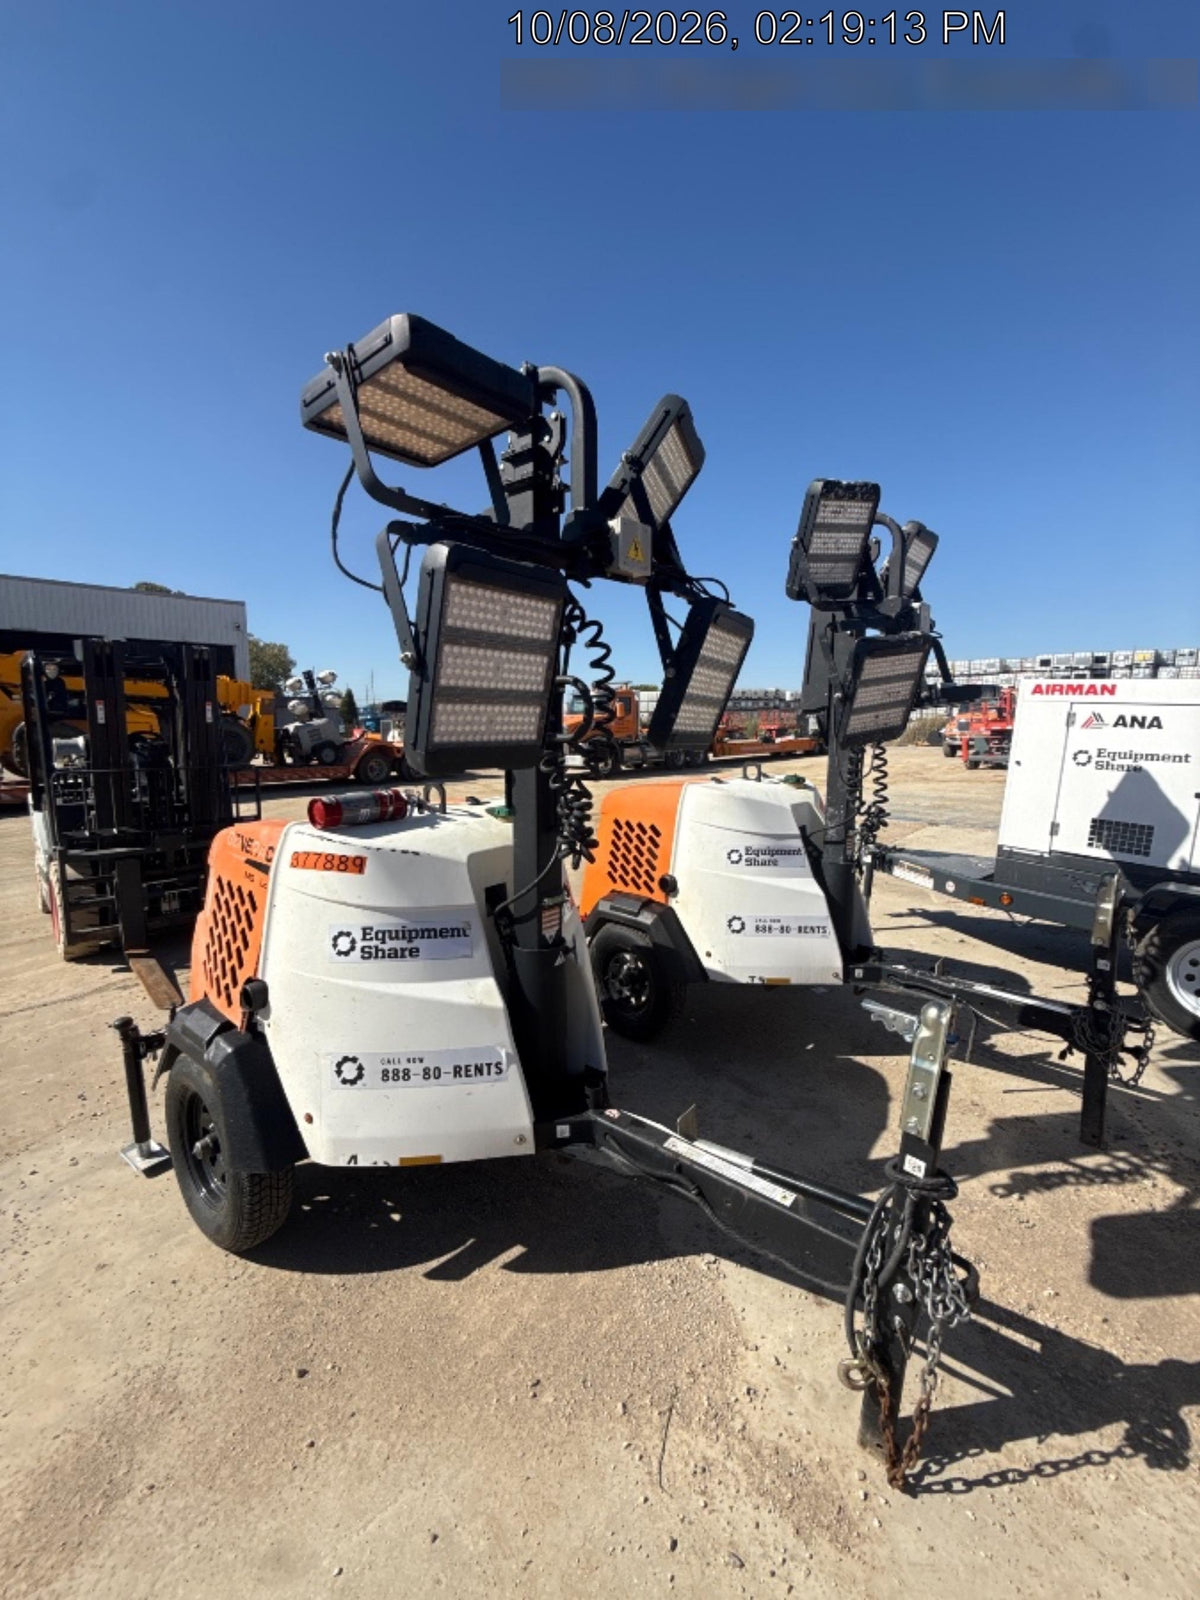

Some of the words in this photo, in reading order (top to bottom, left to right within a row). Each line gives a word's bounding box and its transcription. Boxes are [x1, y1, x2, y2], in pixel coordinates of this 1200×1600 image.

[1031, 683, 1117, 696] AIRMAN
[1112, 714, 1163, 730] ANA
[1095, 748, 1192, 763] Equipment
[1094, 759, 1143, 773] Share
[744, 846, 802, 857] Equipment
[291, 851, 364, 874] 377889
[744, 856, 778, 867] Share
[360, 925, 471, 945] Equipment
[360, 945, 420, 961] Share
[381, 1061, 503, 1083] 888-80-RENTS
